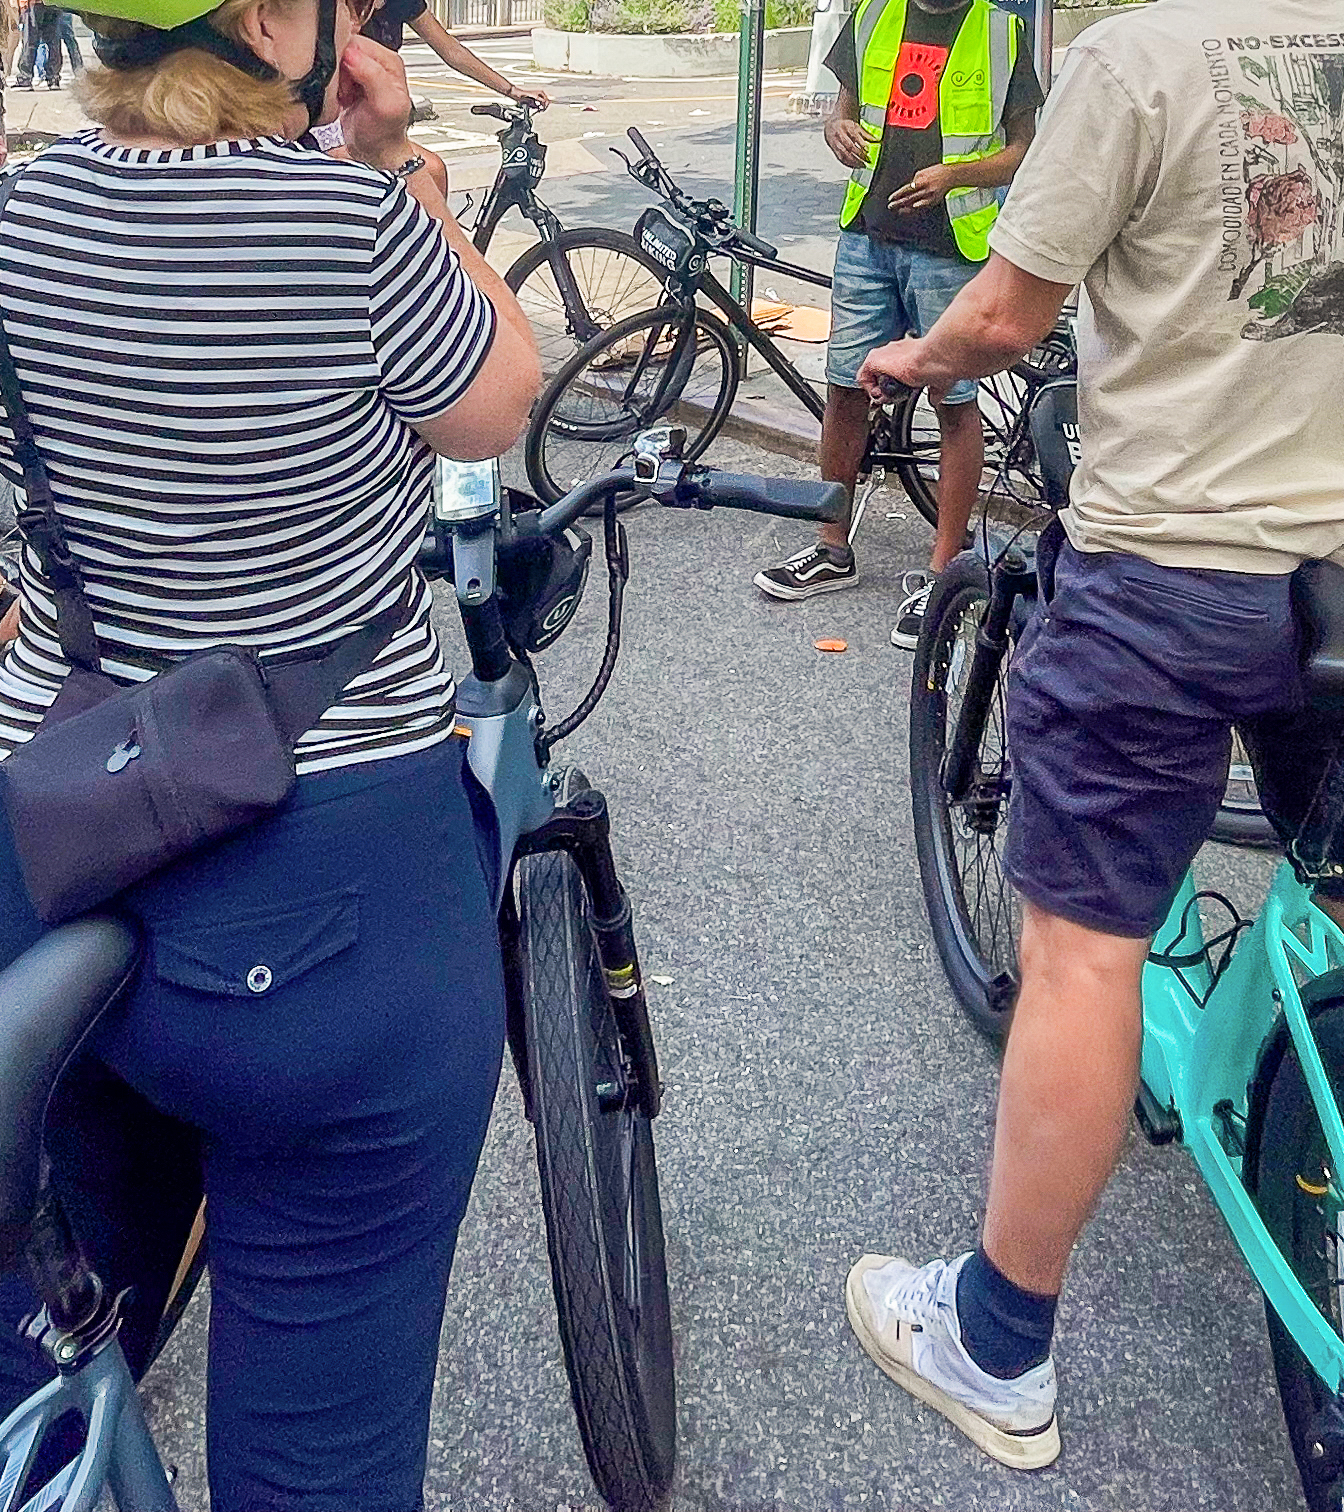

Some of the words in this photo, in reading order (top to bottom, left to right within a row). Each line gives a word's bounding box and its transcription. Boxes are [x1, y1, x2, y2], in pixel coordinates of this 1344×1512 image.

[1219, 119, 1240, 158] CADA
[1221, 164, 1240, 182] EN
[1217, 187, 1241, 272] COMODIDAD
